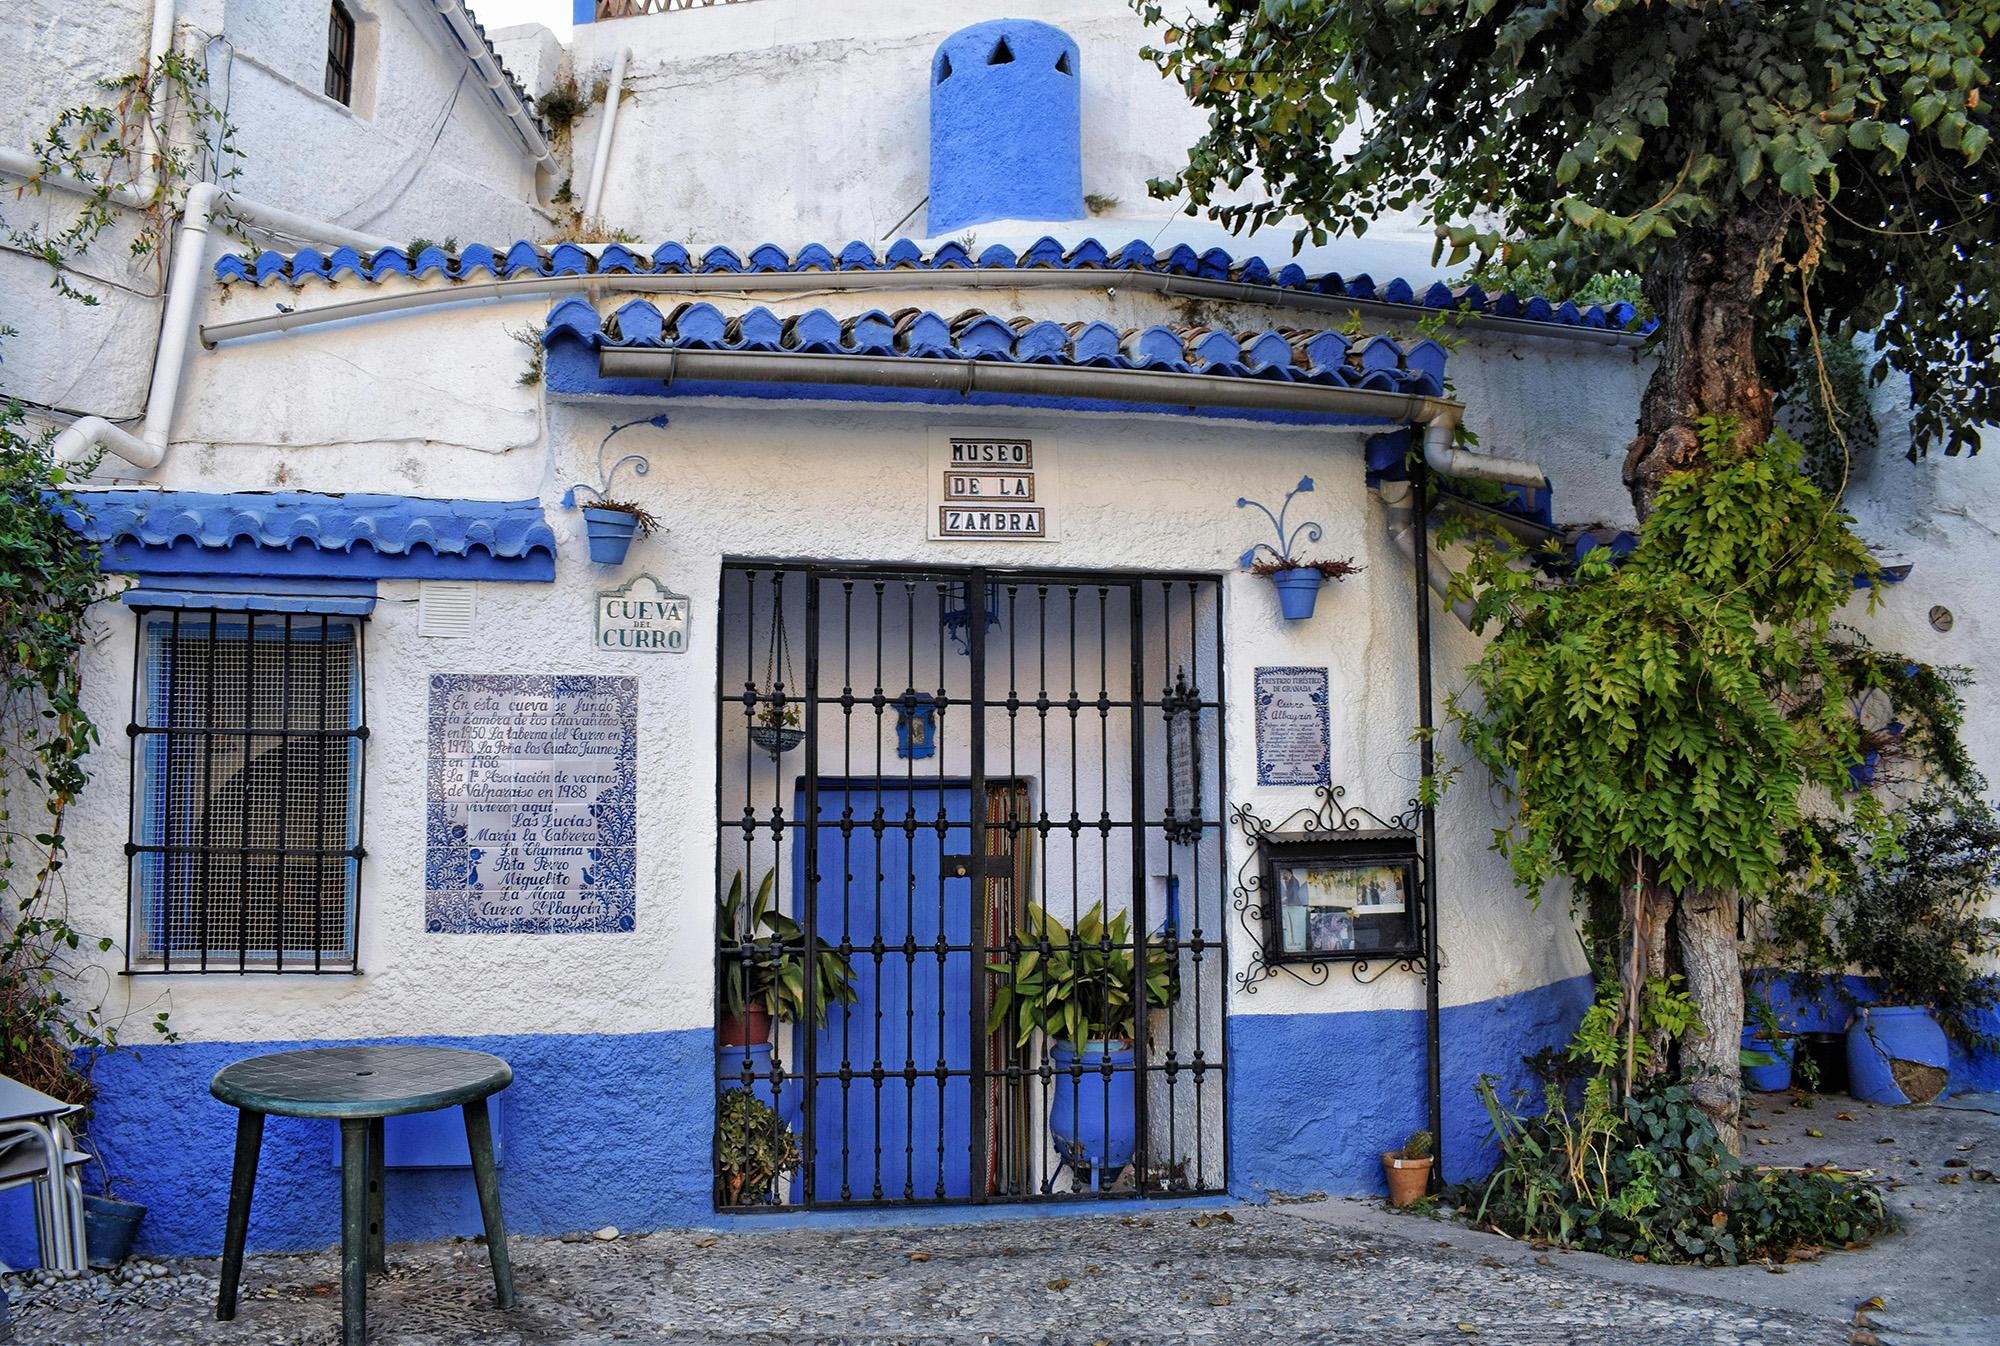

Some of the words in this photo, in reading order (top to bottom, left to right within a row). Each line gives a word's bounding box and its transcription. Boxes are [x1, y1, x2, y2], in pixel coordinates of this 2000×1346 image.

[952, 444, 1023, 462] MUSEO
[954, 478, 980, 495] DE
[1000, 479, 1026, 496] LA
[949, 513, 1037, 531] ZAMBRA
[606, 601, 682, 621] CUEVA
[603, 629, 682, 649] CURRO
[452, 694, 469, 710] En
[508, 701, 548, 711] cueva
[555, 702, 567, 711] se
[1277, 699, 1305, 708] Curro
[448, 711, 460, 724] la
[463, 711, 511, 725] Zambra
[514, 713, 527, 725] de
[530, 713, 547, 725] los
[447, 730, 459, 739] en
[487, 726, 504, 740] La
[507, 727, 548, 740] taberna
[551, 727, 568, 740] del
[570, 727, 605, 741] Curro
[607, 732, 620, 740] en
[477, 740, 493, 754] La
[525, 741, 541, 754] los
[542, 741, 578, 754] Cuatro
[578, 741, 618, 757] Juanes
[449, 759, 464, 768] en
[447, 768, 463, 783] La
[554, 770, 569, 783] de
[574, 774, 617, 783] vecinos
[448, 784, 462, 797] de
[538, 788, 553, 797] en
[450, 803, 458, 818] y
[466, 801, 518, 812] vivieron
[511, 812, 538, 827] Las
[542, 813, 592, 827] Lucías
[472, 828, 517, 842] María
[522, 828, 537, 841] la
[500, 842, 519, 856] La
[523, 842, 584, 856] Chumina
[533, 857, 570, 872] Perro
[499, 872, 571, 890] Miguelito
[500, 886, 519, 901] La
[525, 886, 566, 901] Mona
[480, 901, 523, 915] Curro
